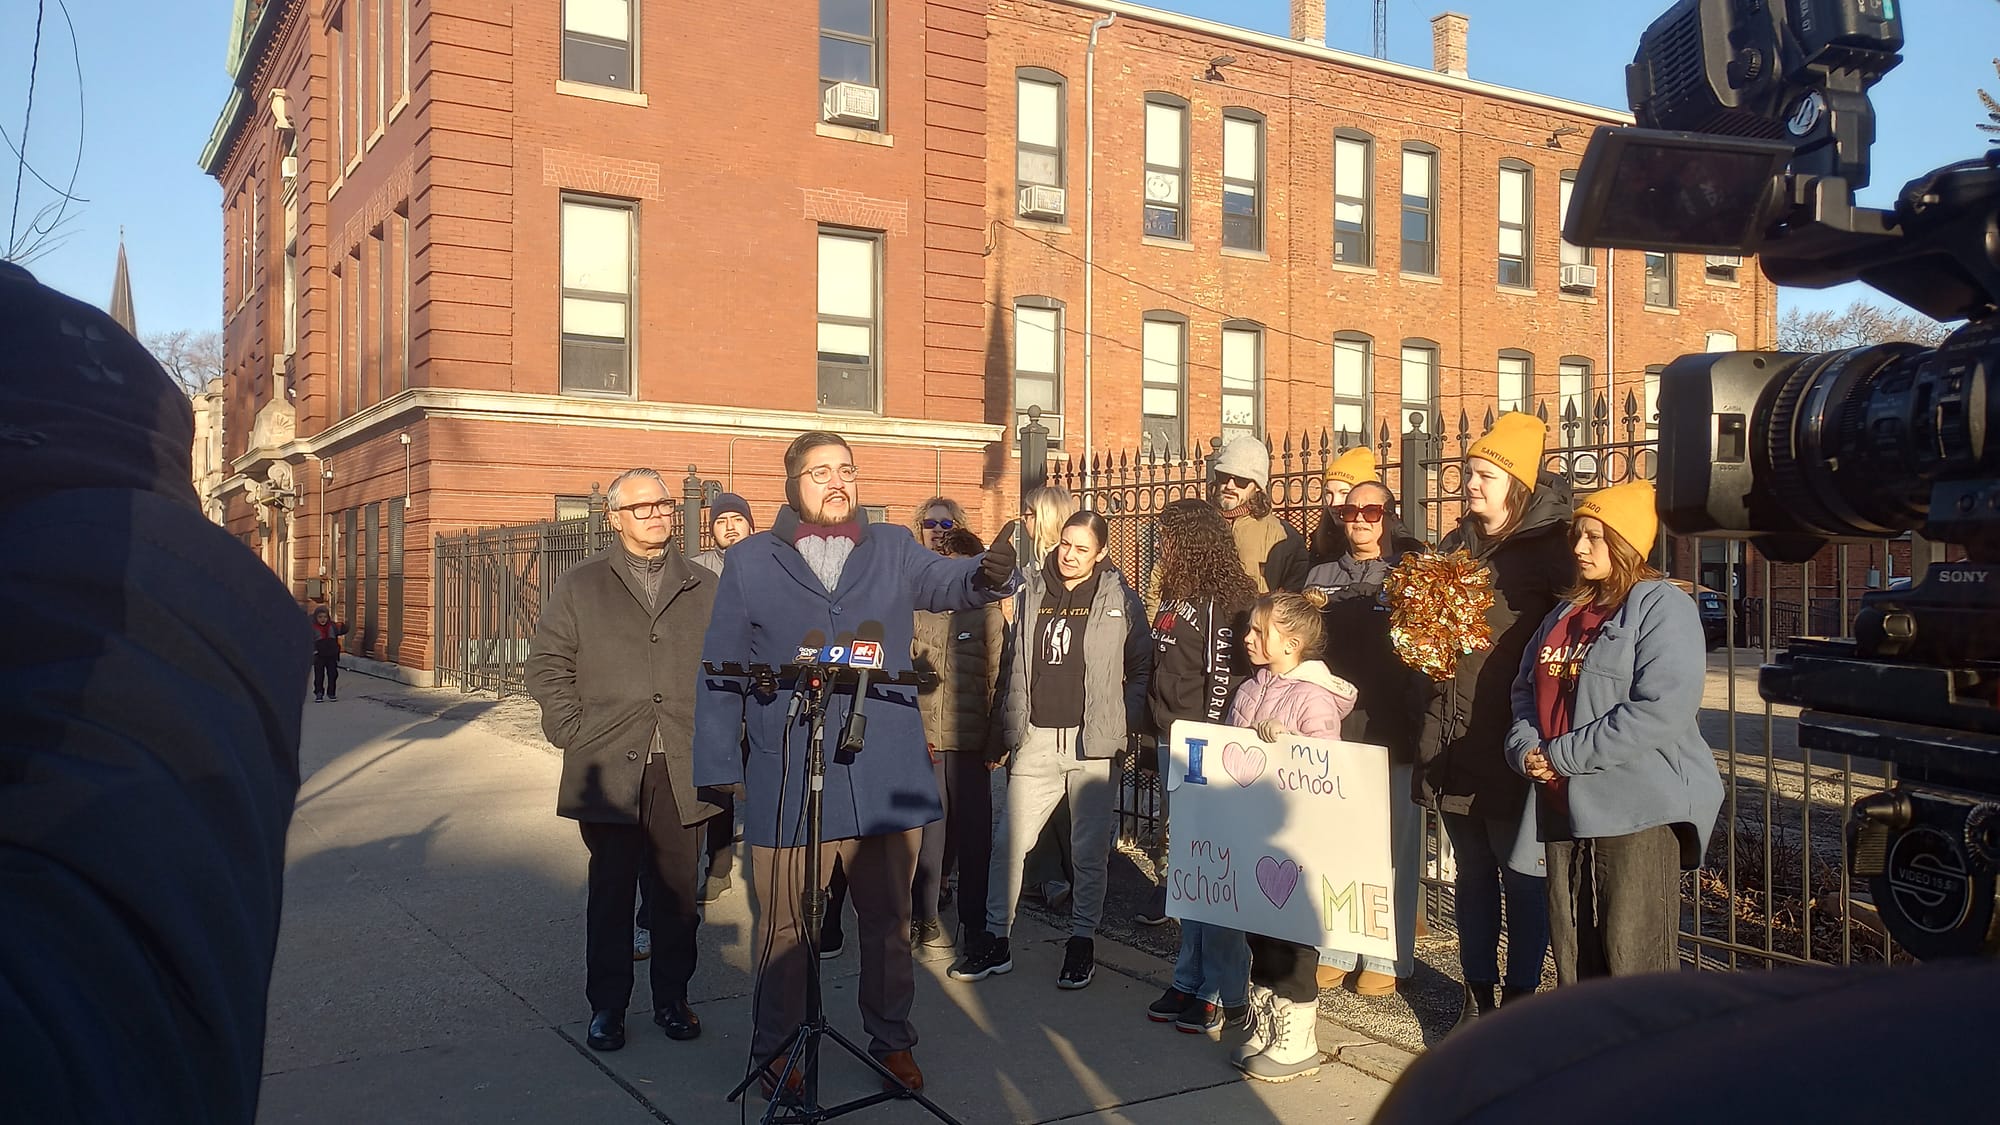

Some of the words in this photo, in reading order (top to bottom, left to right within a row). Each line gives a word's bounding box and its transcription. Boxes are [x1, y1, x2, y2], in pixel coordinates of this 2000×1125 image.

[1480, 447, 1514, 469] SANTIAGO
[1939, 570, 1988, 582] SONY
[829, 646, 845, 663] 9
[1207, 628, 1233, 720] CALIFORN
[1184, 737, 1209, 786] I
[1291, 744, 1329, 780] my
[1277, 768, 1347, 800] school
[1191, 839, 1230, 880] my
[1898, 867, 1931, 886] VIDEO
[1171, 866, 1239, 913] school
[1322, 873, 1389, 941] ME
